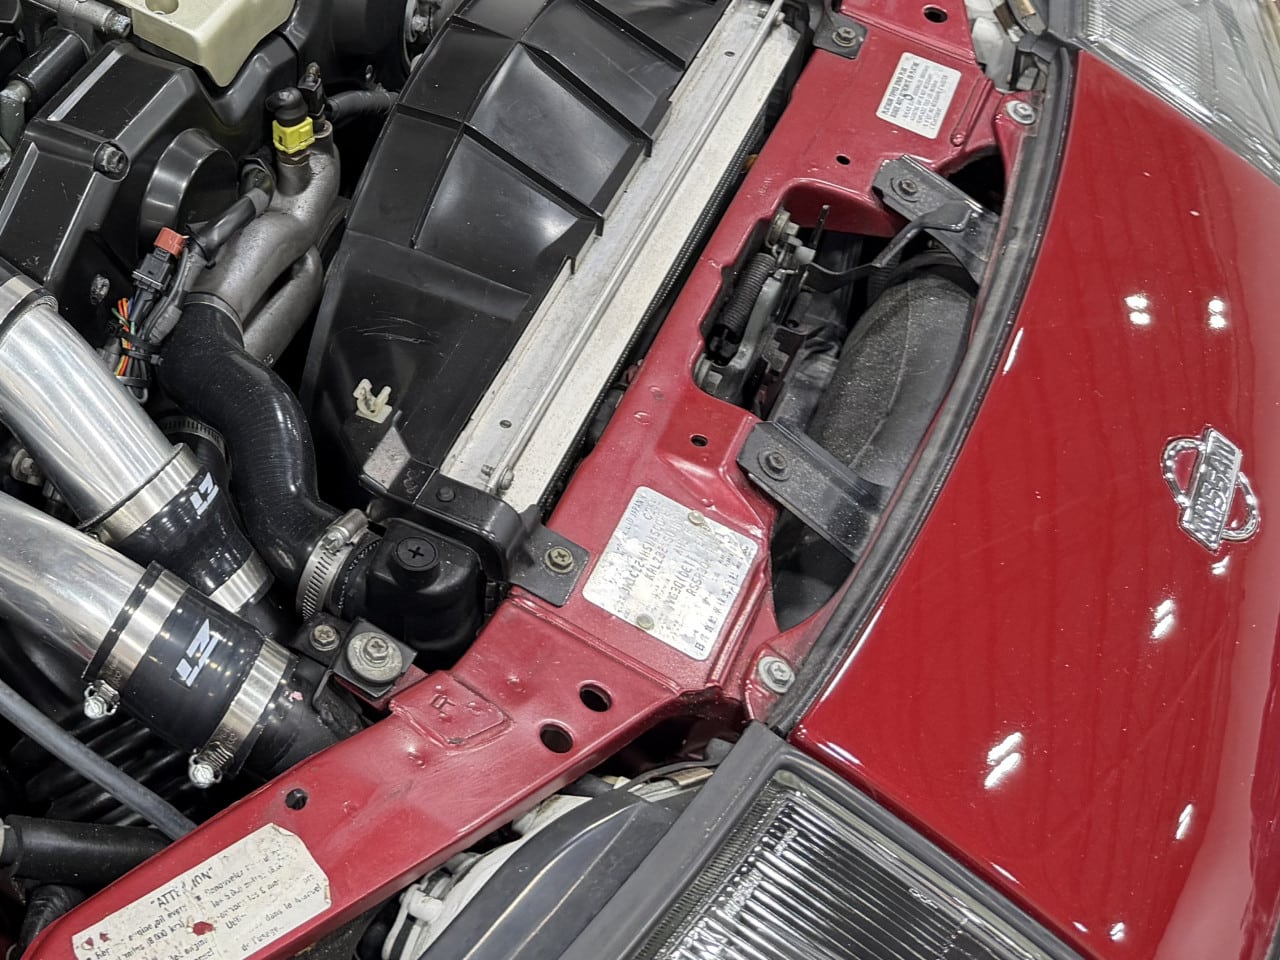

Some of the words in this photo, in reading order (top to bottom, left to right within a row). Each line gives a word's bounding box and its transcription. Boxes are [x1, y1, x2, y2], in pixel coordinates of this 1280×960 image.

[190, 471, 220, 517] Z1
[1184, 435, 1238, 545] NISSAN
[175, 621, 217, 687] Z1
